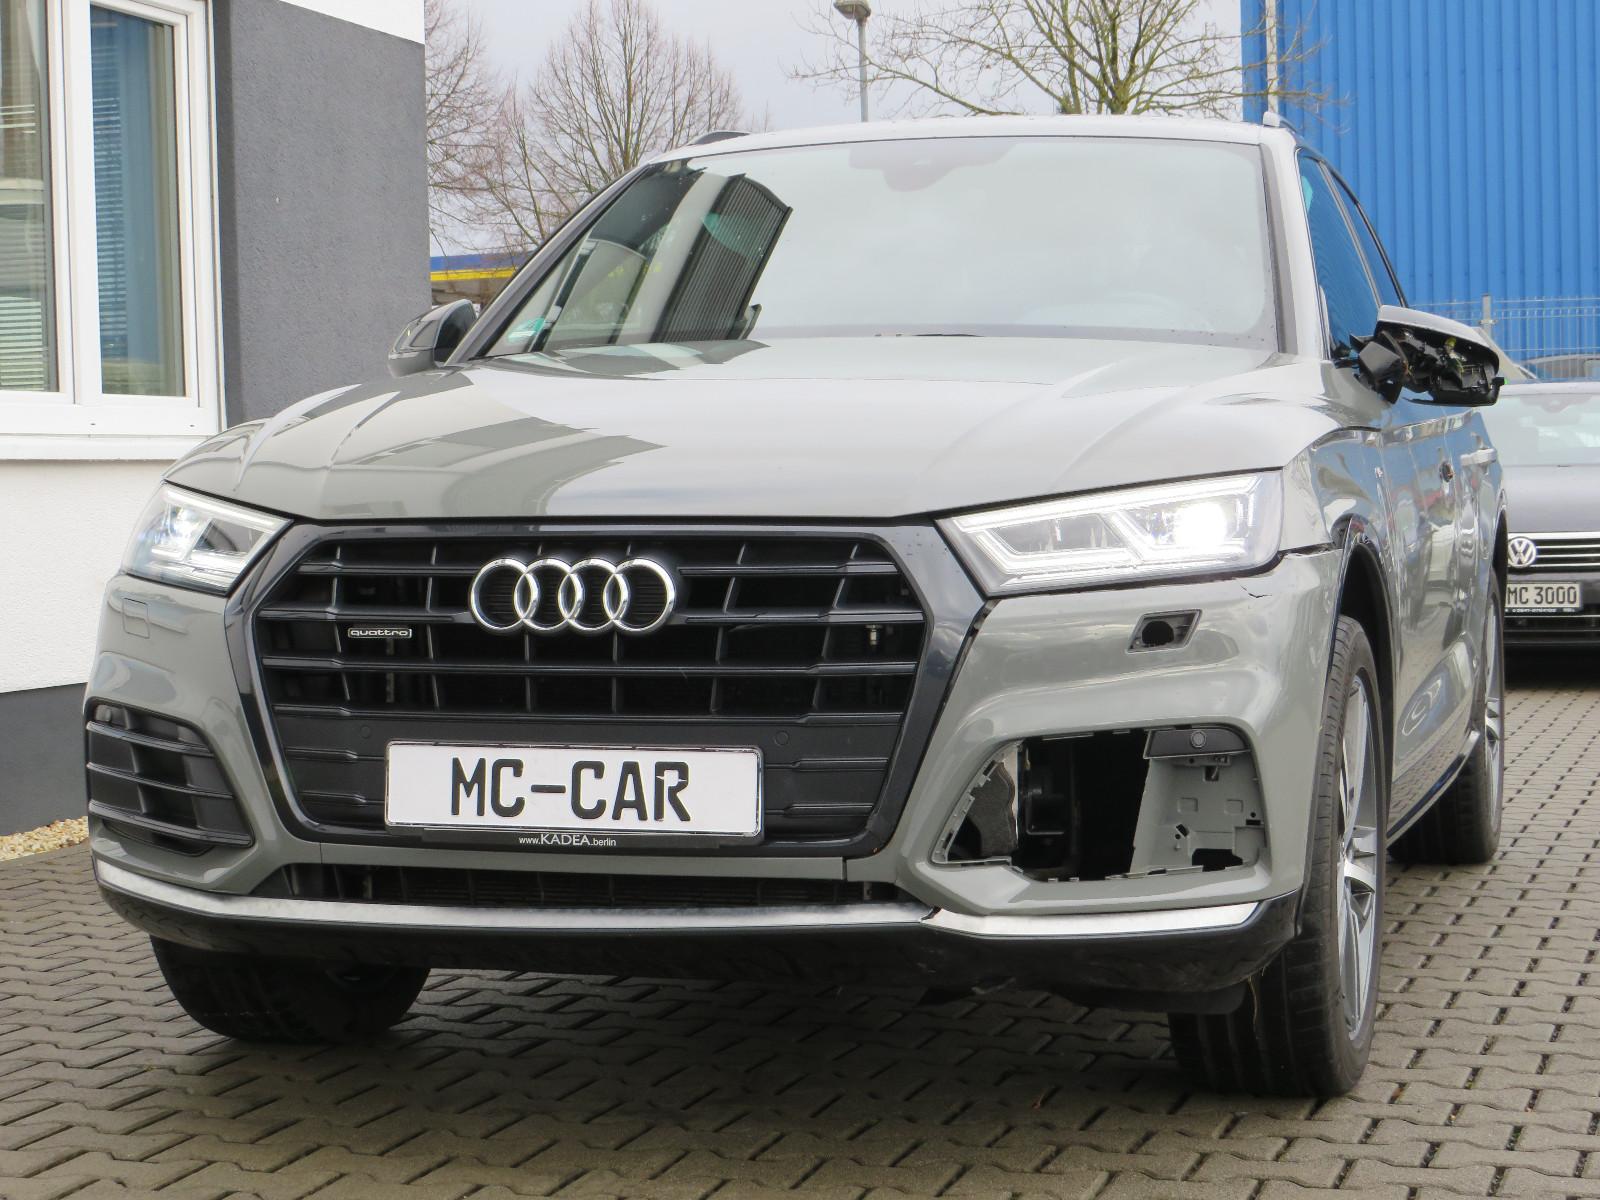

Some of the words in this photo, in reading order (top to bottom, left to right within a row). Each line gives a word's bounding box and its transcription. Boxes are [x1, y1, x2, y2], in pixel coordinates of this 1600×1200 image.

[1507, 586, 1528, 605] MC
[1534, 586, 1577, 605] 3000
[350, 629, 409, 637] quattro
[451, 757, 691, 822] MC-CAR
[519, 833, 617, 847] www.KADEA.berlin
